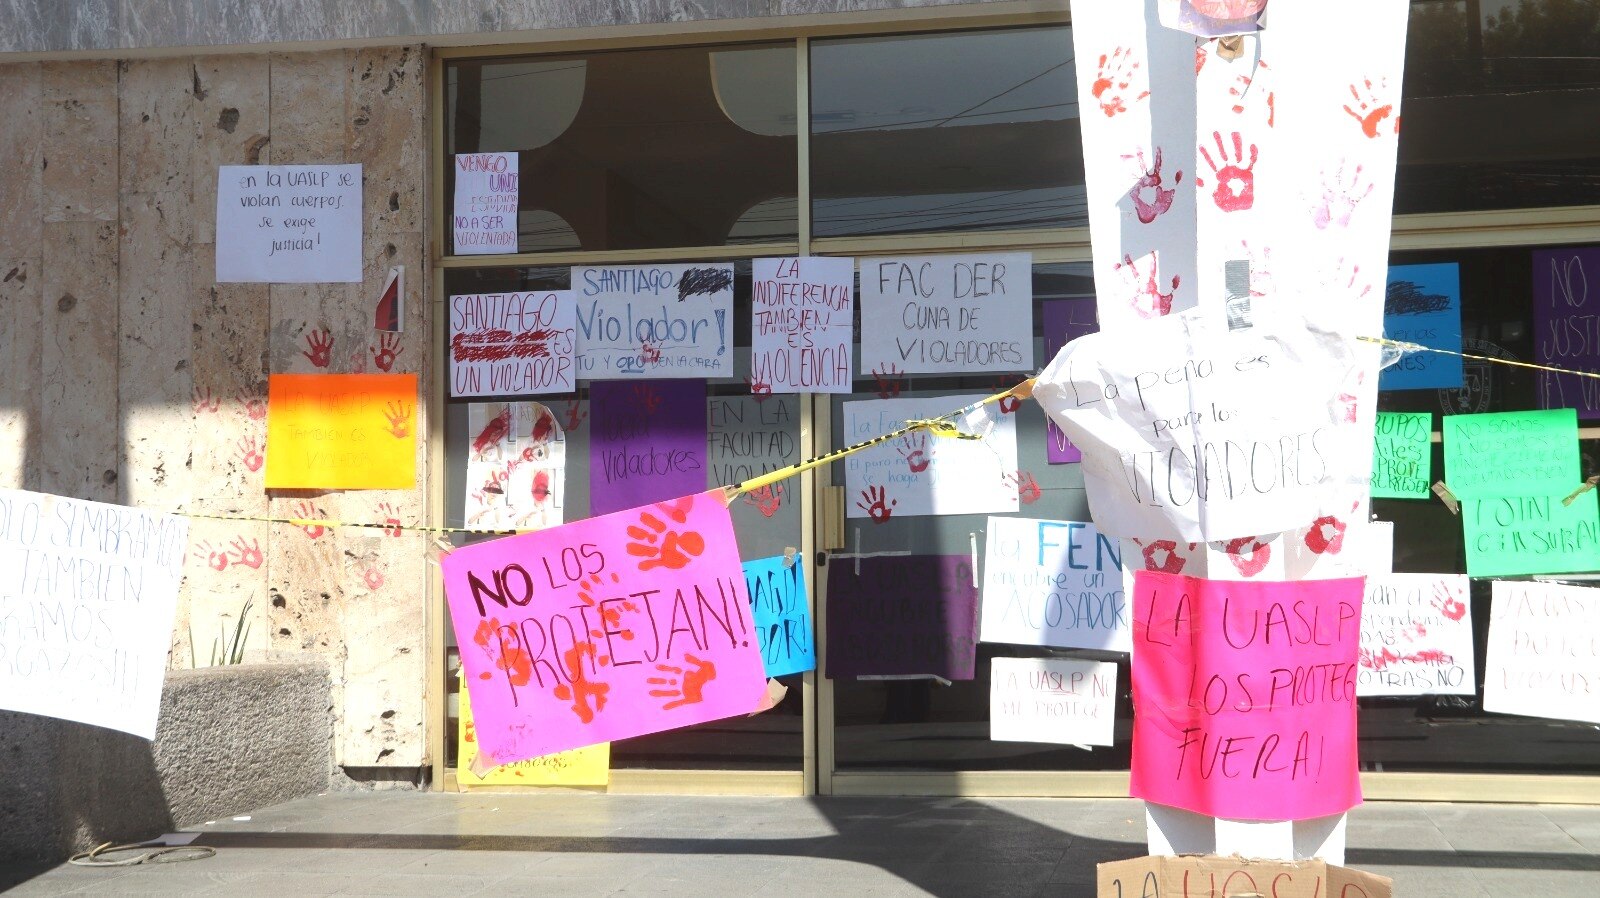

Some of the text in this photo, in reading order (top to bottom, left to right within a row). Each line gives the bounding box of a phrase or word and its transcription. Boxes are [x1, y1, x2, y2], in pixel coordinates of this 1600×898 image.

[456, 154, 508, 173] VENGO
[239, 171, 355, 189] en la UASLP se
[240, 193, 281, 207] violan
[258, 216, 317, 234] se exige
[455, 215, 504, 230] NO A SER
[583, 268, 674, 297] SANTIAGO
[775, 258, 799, 279] LA
[878, 261, 1007, 298] FAC DER
[1551, 255, 1588, 308] NO
[752, 280, 850, 311] INDIFERENCIA
[453, 294, 557, 331] SANTIAGO
[755, 307, 830, 336] TAMBIEN
[902, 301, 981, 331] CUNA DE
[553, 330, 574, 355] ES
[788, 331, 814, 349] ES
[896, 336, 1023, 365] VIOLADORES
[456, 357, 571, 395] UN VIOLADOR
[575, 354, 595, 370] TU
[603, 354, 611, 369] Y
[752, 343, 848, 387] VIOLENCIA
[1069, 360, 1120, 407] La
[709, 399, 790, 427] EN LA
[708, 430, 794, 460] FACULTAD
[467, 543, 605, 618] NO LOS
[1083, 572, 1104, 588] un
[1146, 589, 1356, 650] LA UASLP
[496, 577, 750, 708] PROTEJAN!
[1029, 670, 1084, 692] UASLP
[1186, 664, 1254, 716] LOS
[1437, 665, 1465, 688] NO
